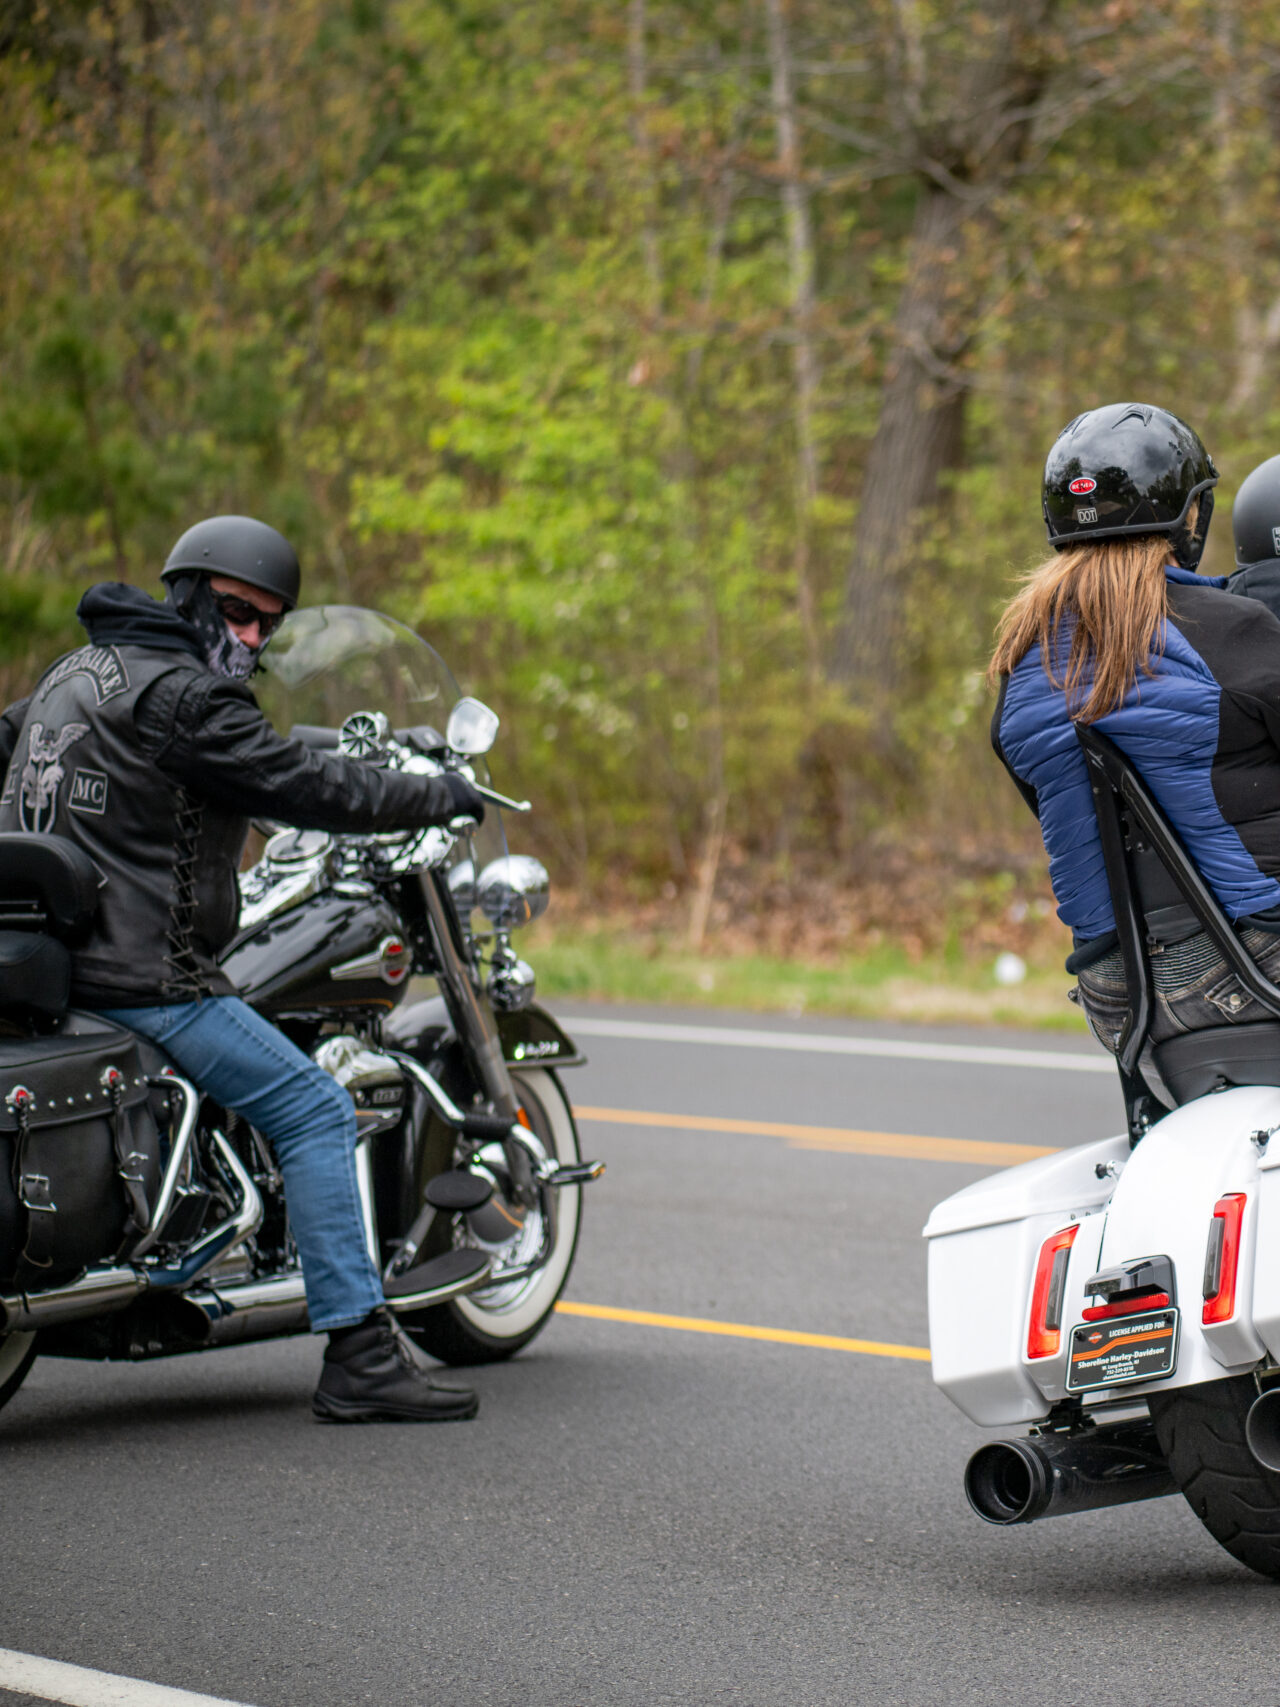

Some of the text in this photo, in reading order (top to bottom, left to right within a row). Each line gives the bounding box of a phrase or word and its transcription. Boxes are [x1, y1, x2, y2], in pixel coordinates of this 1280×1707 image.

[1079, 510, 1096, 522] DOT
[73, 776, 105, 804] MC
[1109, 1327, 1131, 1338] LICENSE
[1131, 1323, 1153, 1333] APPLIED
[1154, 1321, 1165, 1329] FOR
[1077, 1347, 1166, 1369] Shoreline Harley-Davidson
